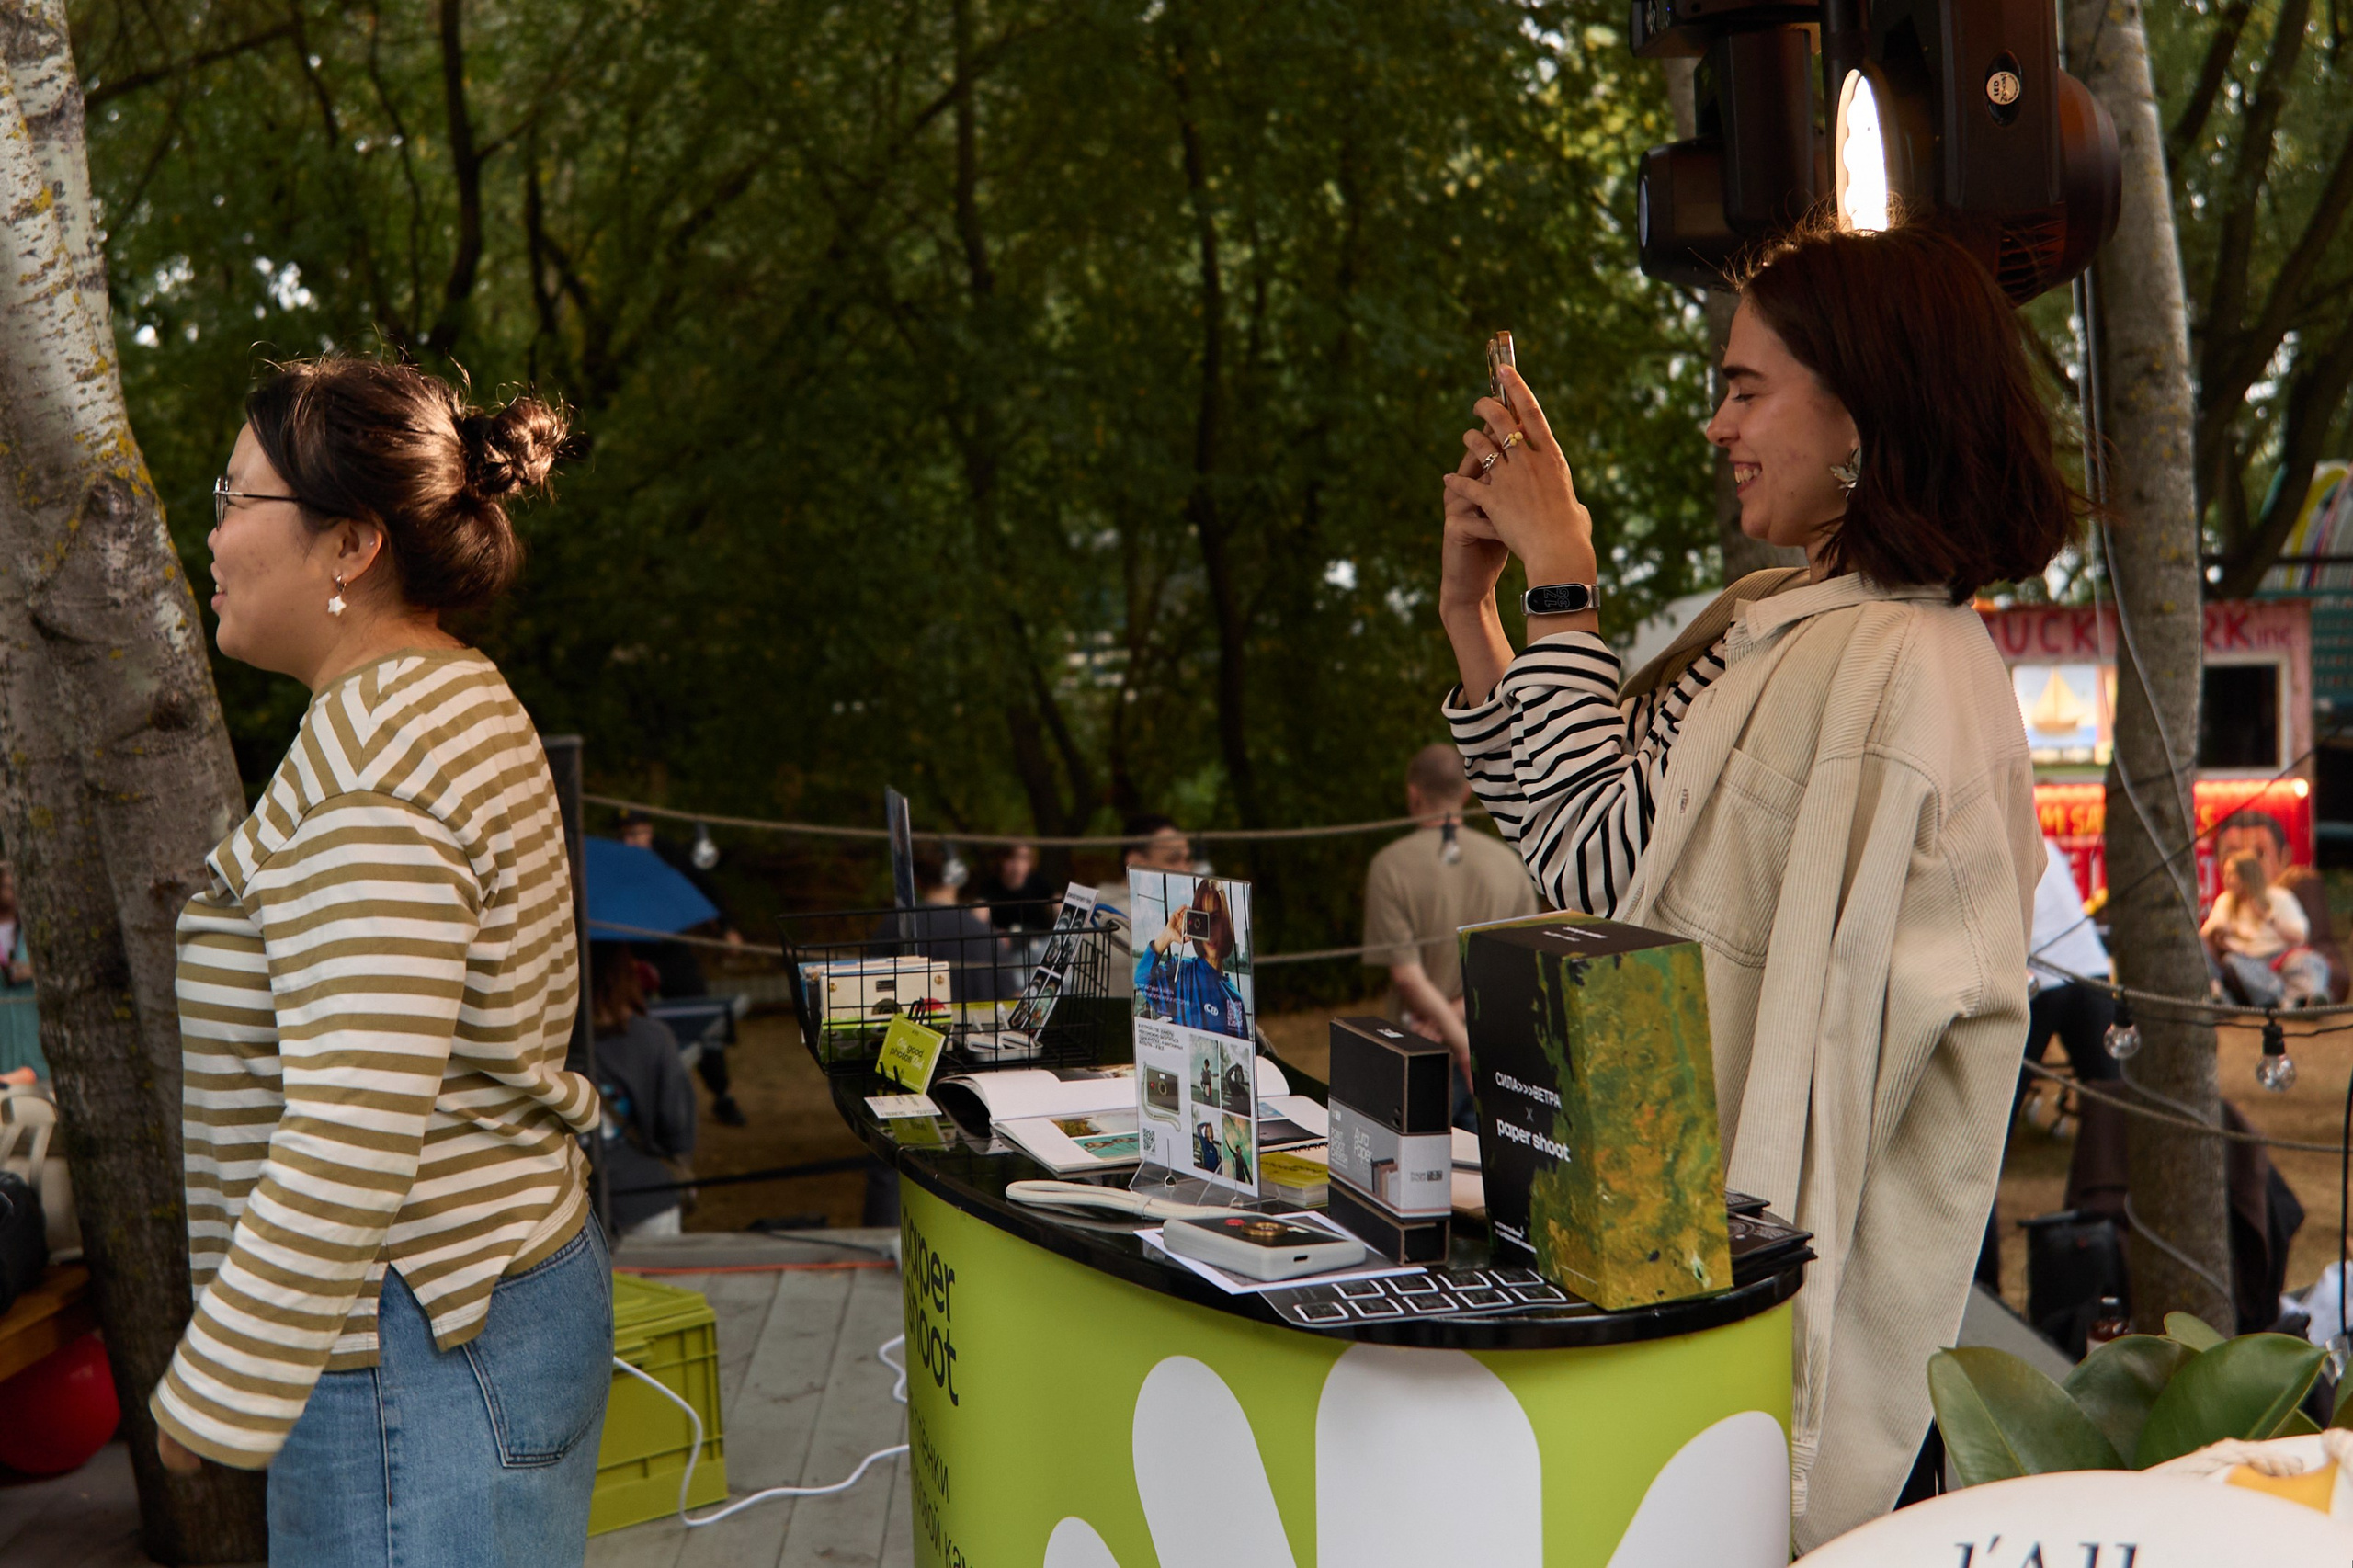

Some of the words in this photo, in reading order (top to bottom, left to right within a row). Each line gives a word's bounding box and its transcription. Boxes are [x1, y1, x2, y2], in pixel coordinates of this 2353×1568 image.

[890, 1047, 913, 1063] photos
[907, 1045, 925, 1058] good
[1495, 1118, 1532, 1146] paper
[1531, 1131, 1572, 1163] shoot
[903, 1203, 956, 1324] paper
[906, 1275, 959, 1407] shoot
